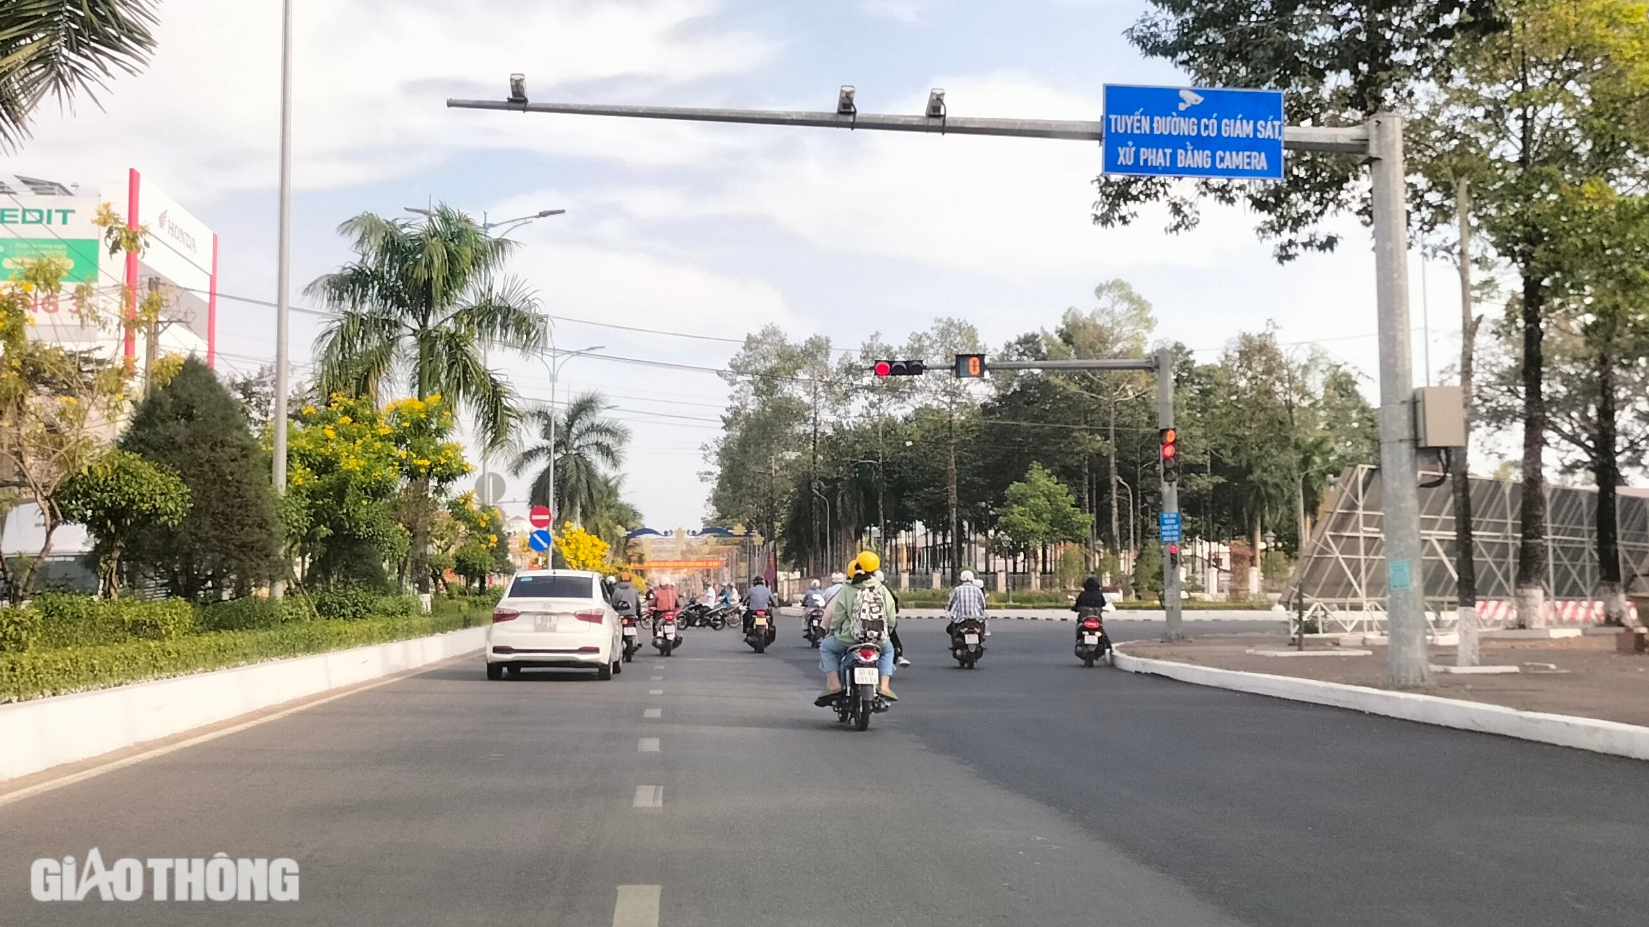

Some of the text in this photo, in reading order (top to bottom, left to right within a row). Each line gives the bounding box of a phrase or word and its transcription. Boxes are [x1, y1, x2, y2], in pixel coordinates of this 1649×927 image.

[1109, 108, 1282, 141] TUYẾN ĐƯỜNG CÓ GIÁM SÁT,
[1117, 141, 1268, 170] XỬ PHẠT BẰNG CAMERA
[0, 208, 75, 225] EDIT
[168, 219, 197, 253] HONDA
